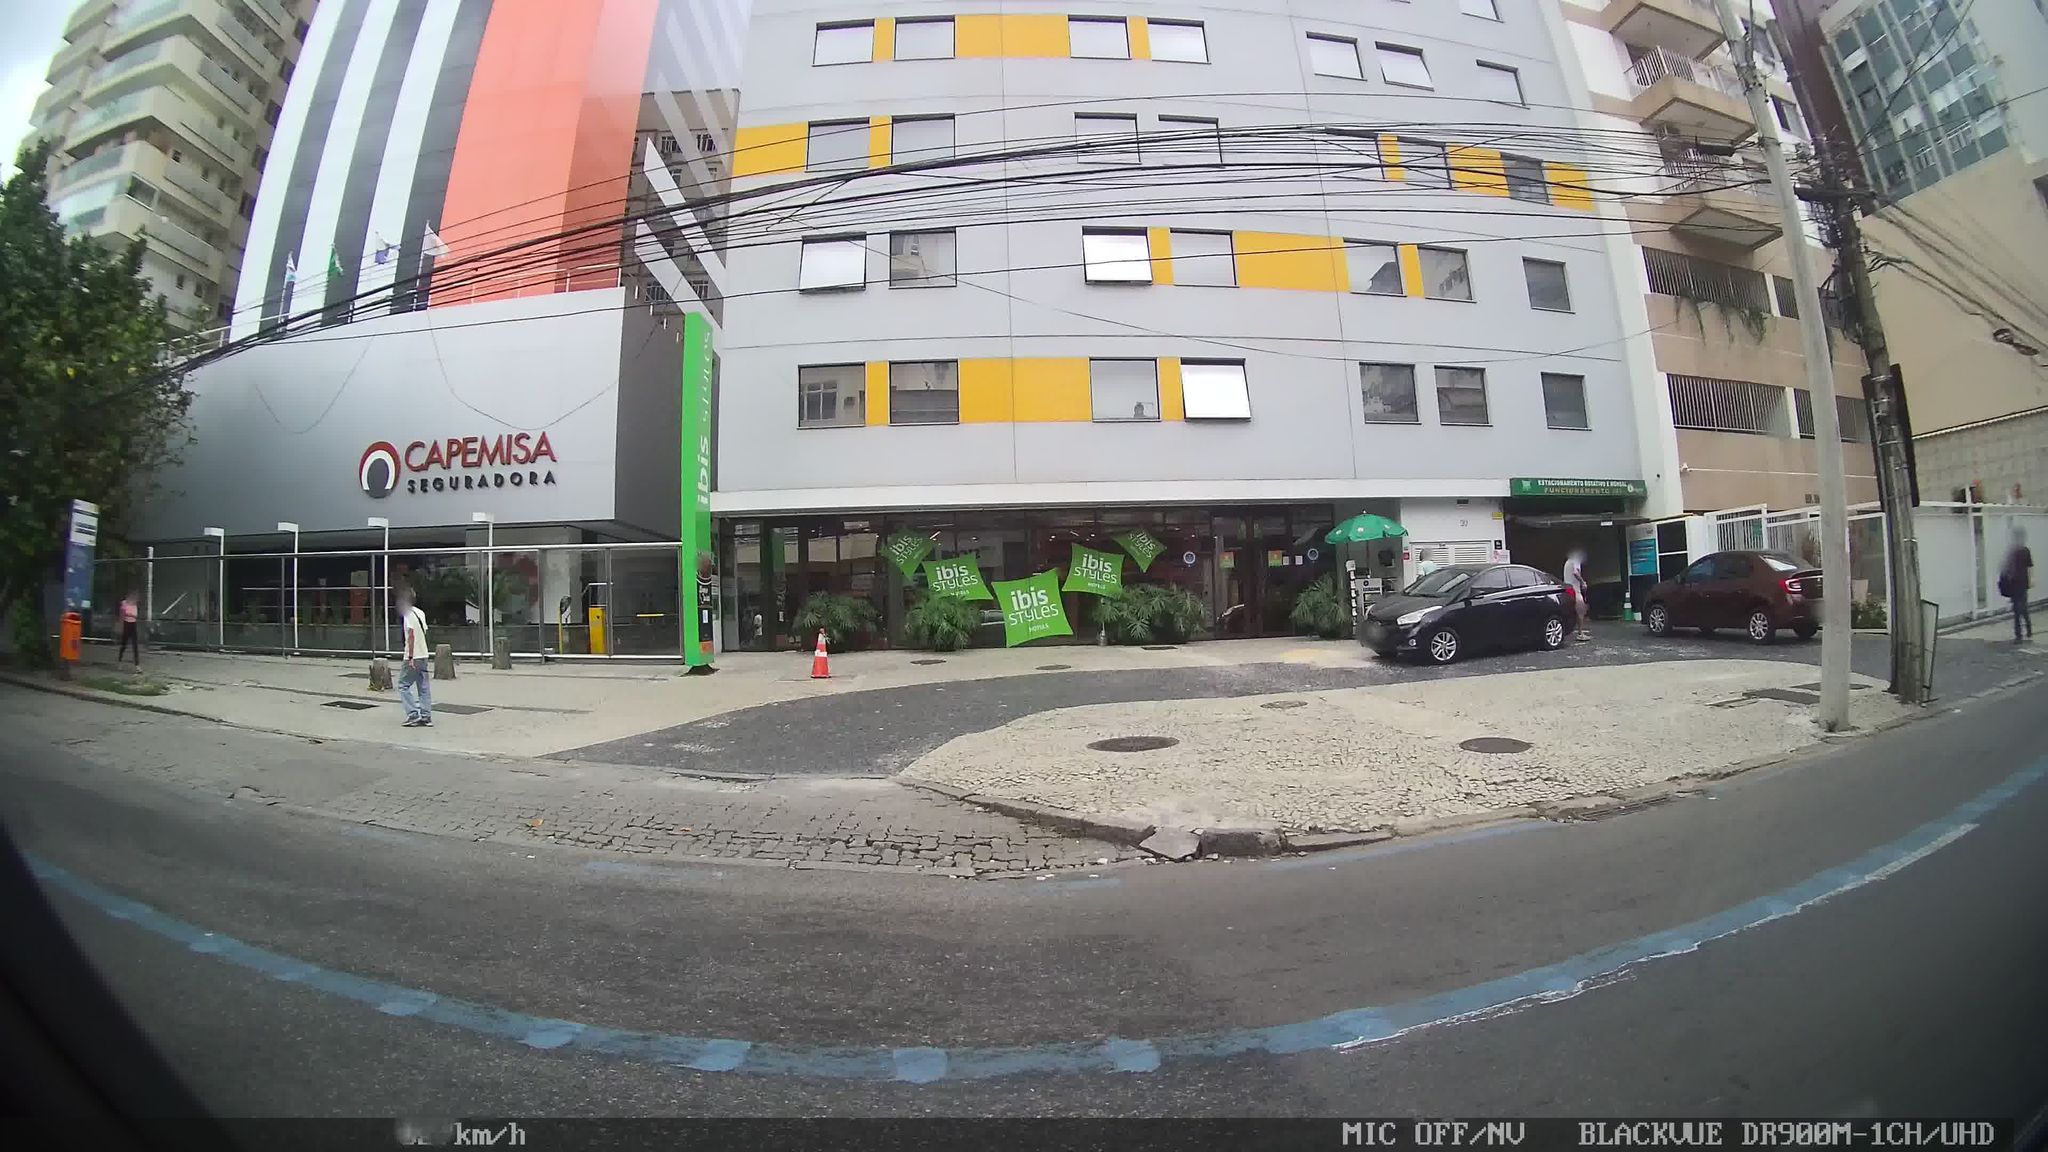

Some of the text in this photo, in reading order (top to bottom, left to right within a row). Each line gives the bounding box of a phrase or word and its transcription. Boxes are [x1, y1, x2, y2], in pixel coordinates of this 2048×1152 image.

[404, 431, 557, 472] CAPEMISA
[697, 435, 710, 505] ibis
[407, 469, 557, 494] SEGURADORA
[890, 535, 913, 555] ibis
[1135, 531, 1156, 550] ibis
[935, 563, 969, 581] ibis
[1082, 553, 1112, 573] ibis
[932, 574, 979, 593] STYLES
[1073, 566, 1118, 584] STYLES
[1011, 587, 1049, 611] ibis
[1008, 603, 1059, 627] STYLES
